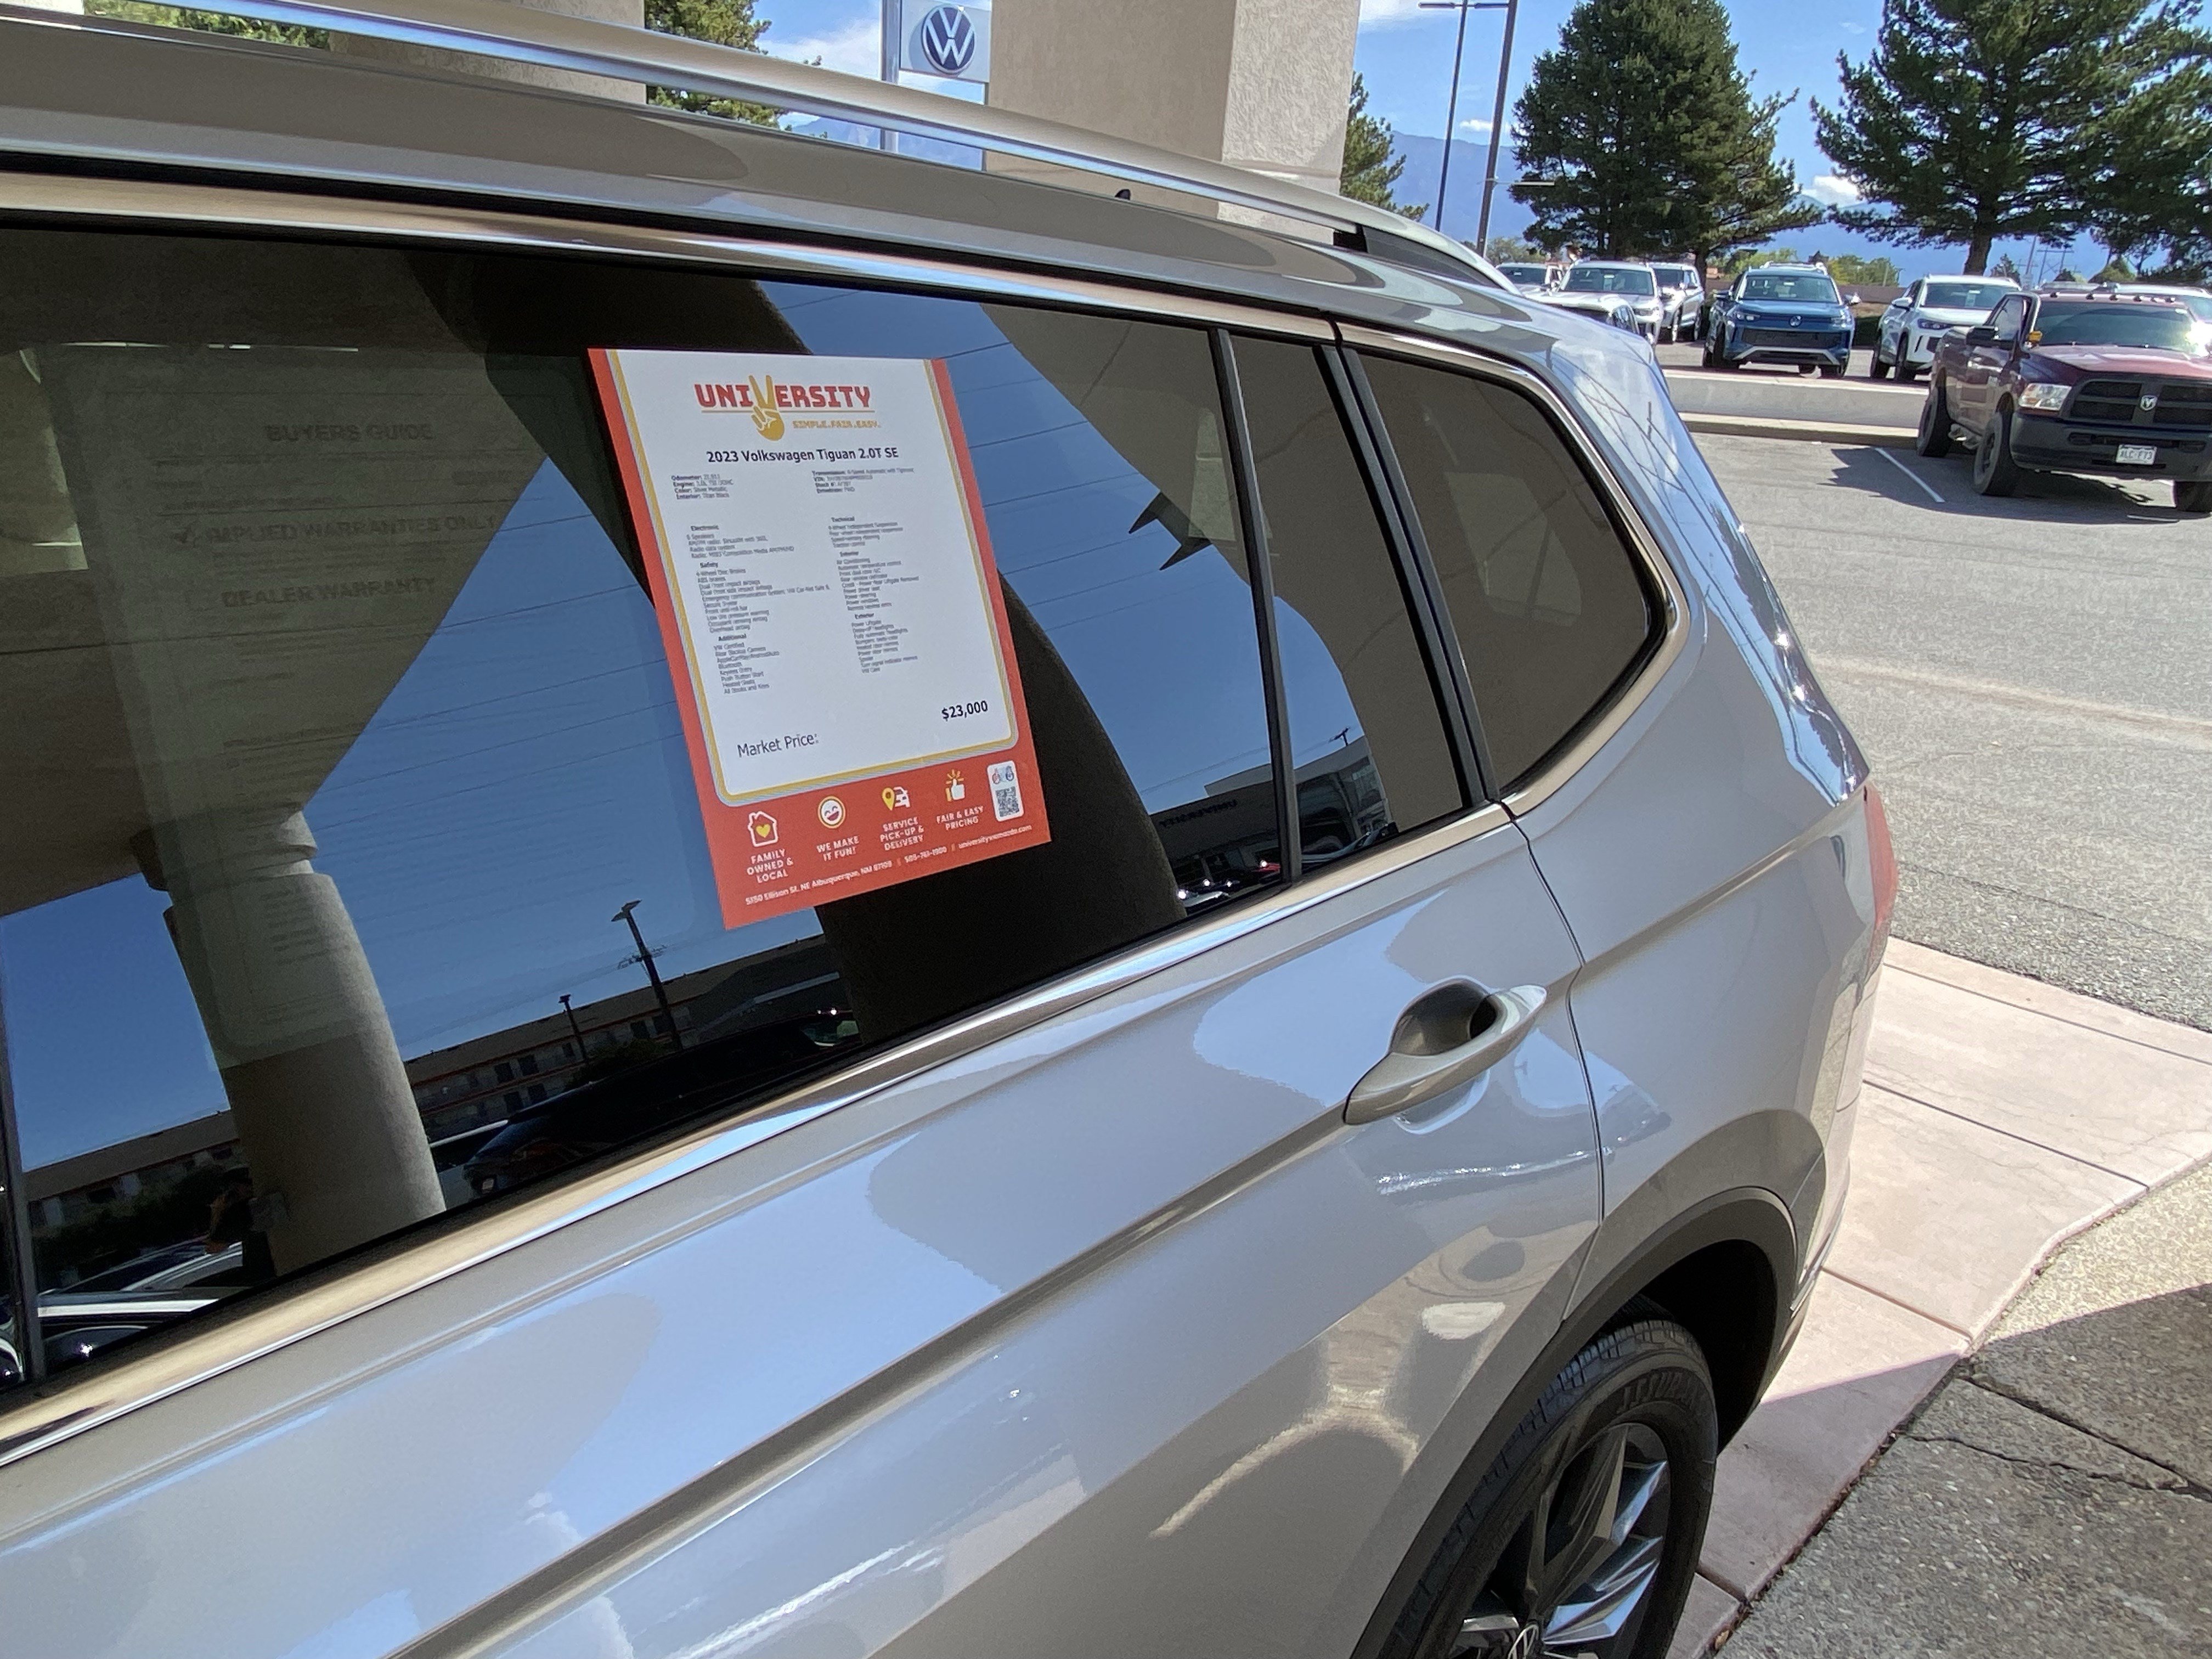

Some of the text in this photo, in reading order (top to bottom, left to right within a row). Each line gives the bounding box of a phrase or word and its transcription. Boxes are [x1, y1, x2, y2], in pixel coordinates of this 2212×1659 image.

[923, 5, 975, 71] VW
[694, 375, 871, 409] UNIVERSITY
[266, 422, 433, 442] BUYERS GUIDE
[706, 447, 899, 465] 2023 Volkswagen Tiguan 2.0T SE
[941, 699, 989, 723] $23,000
[737, 732, 820, 758] Market Price:
[936, 812, 955, 823] FAIR
[964, 805, 984, 817] EASY
[882, 816, 919, 832] SERVICE
[945, 816, 979, 831] PRICING
[880, 827, 916, 842] PICK-UP
[884, 834, 924, 851] DELIVERY
[816, 836, 860, 853] WE MAKE
[751, 848, 786, 865] FAMILY
[823, 846, 856, 862] IT FUN!
[746, 856, 794, 876] OWNED &
[757, 868, 788, 883] LOCAL
